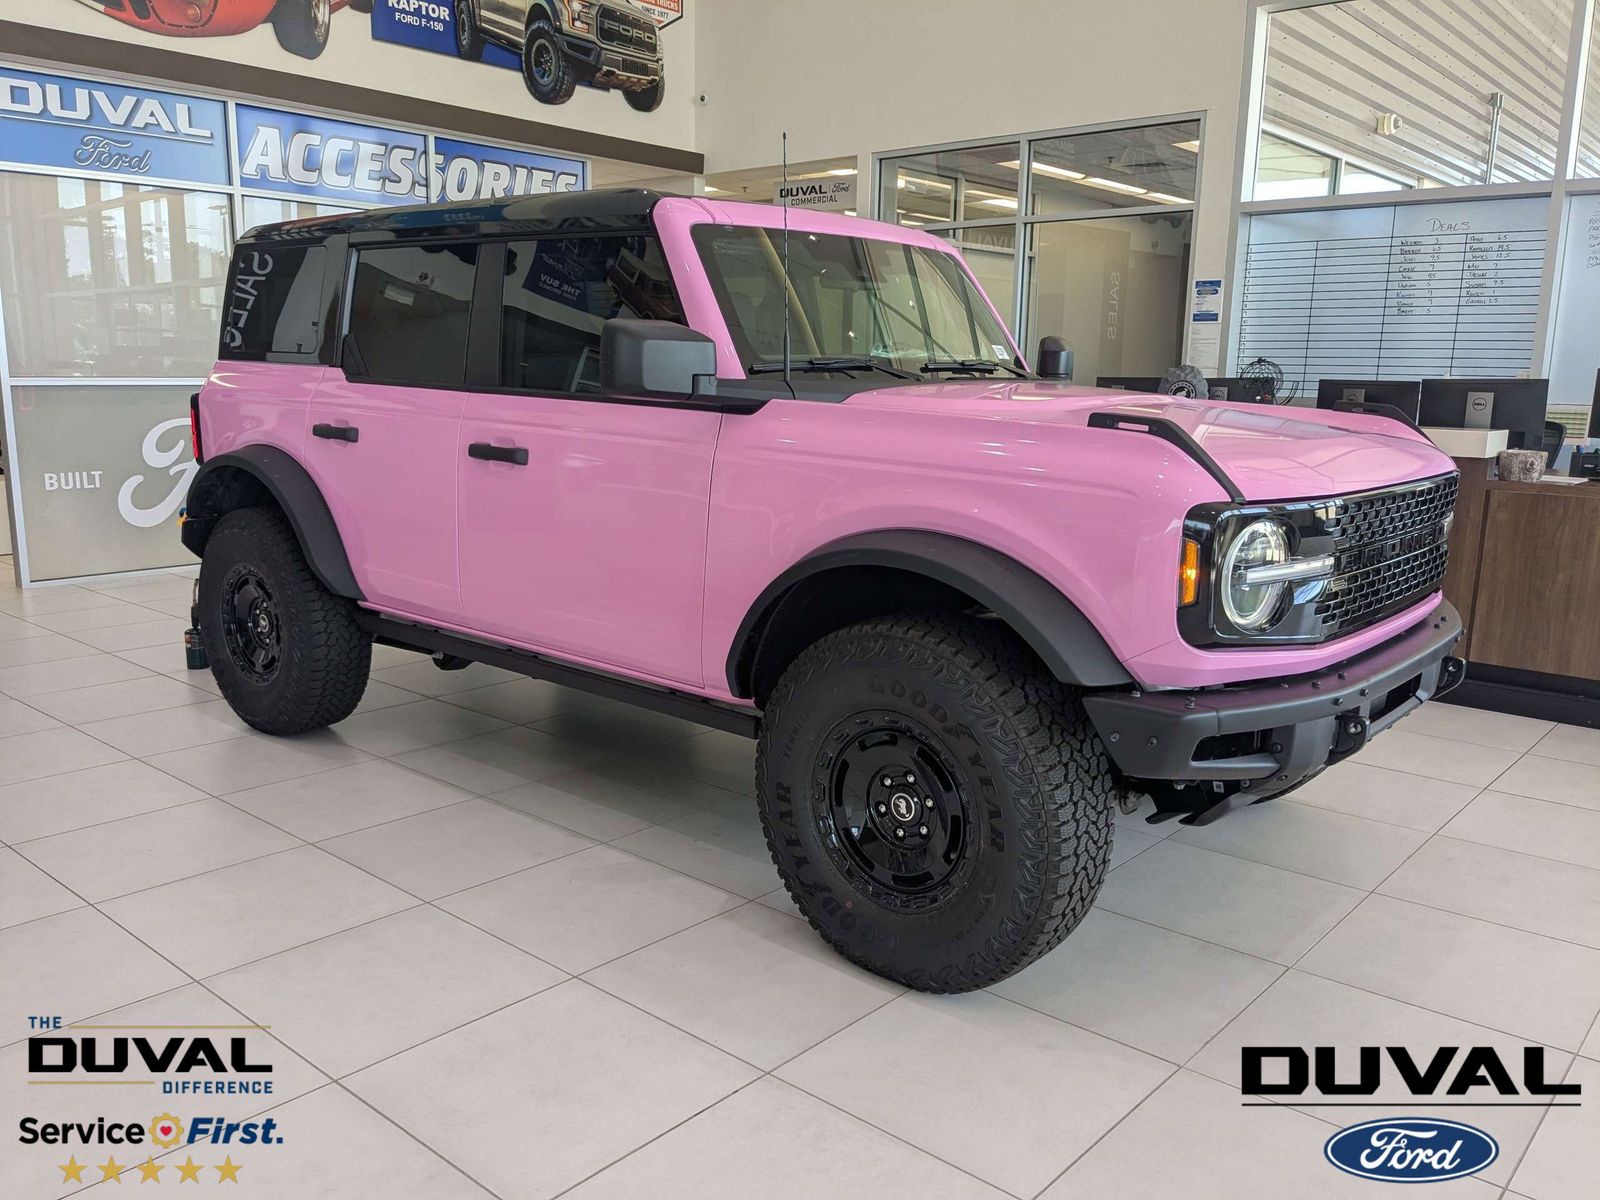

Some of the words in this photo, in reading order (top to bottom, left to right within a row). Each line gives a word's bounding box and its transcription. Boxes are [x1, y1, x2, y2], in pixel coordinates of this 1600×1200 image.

[388, 0, 450, 21] RAPTOR
[641, 5, 656, 16] SINCE
[395, 12, 419, 26] FORD
[422, 19, 444, 32] F-150
[604, 20, 656, 42] FORD
[0, 78, 213, 138] DUVAL
[73, 134, 151, 174] Ford
[780, 184, 827, 198] DUVAL
[832, 182, 850, 194] Ford
[791, 195, 838, 206] COMMERCIAL
[1426, 217, 1471, 232] DEALS
[44, 471, 103, 491] BUILT
